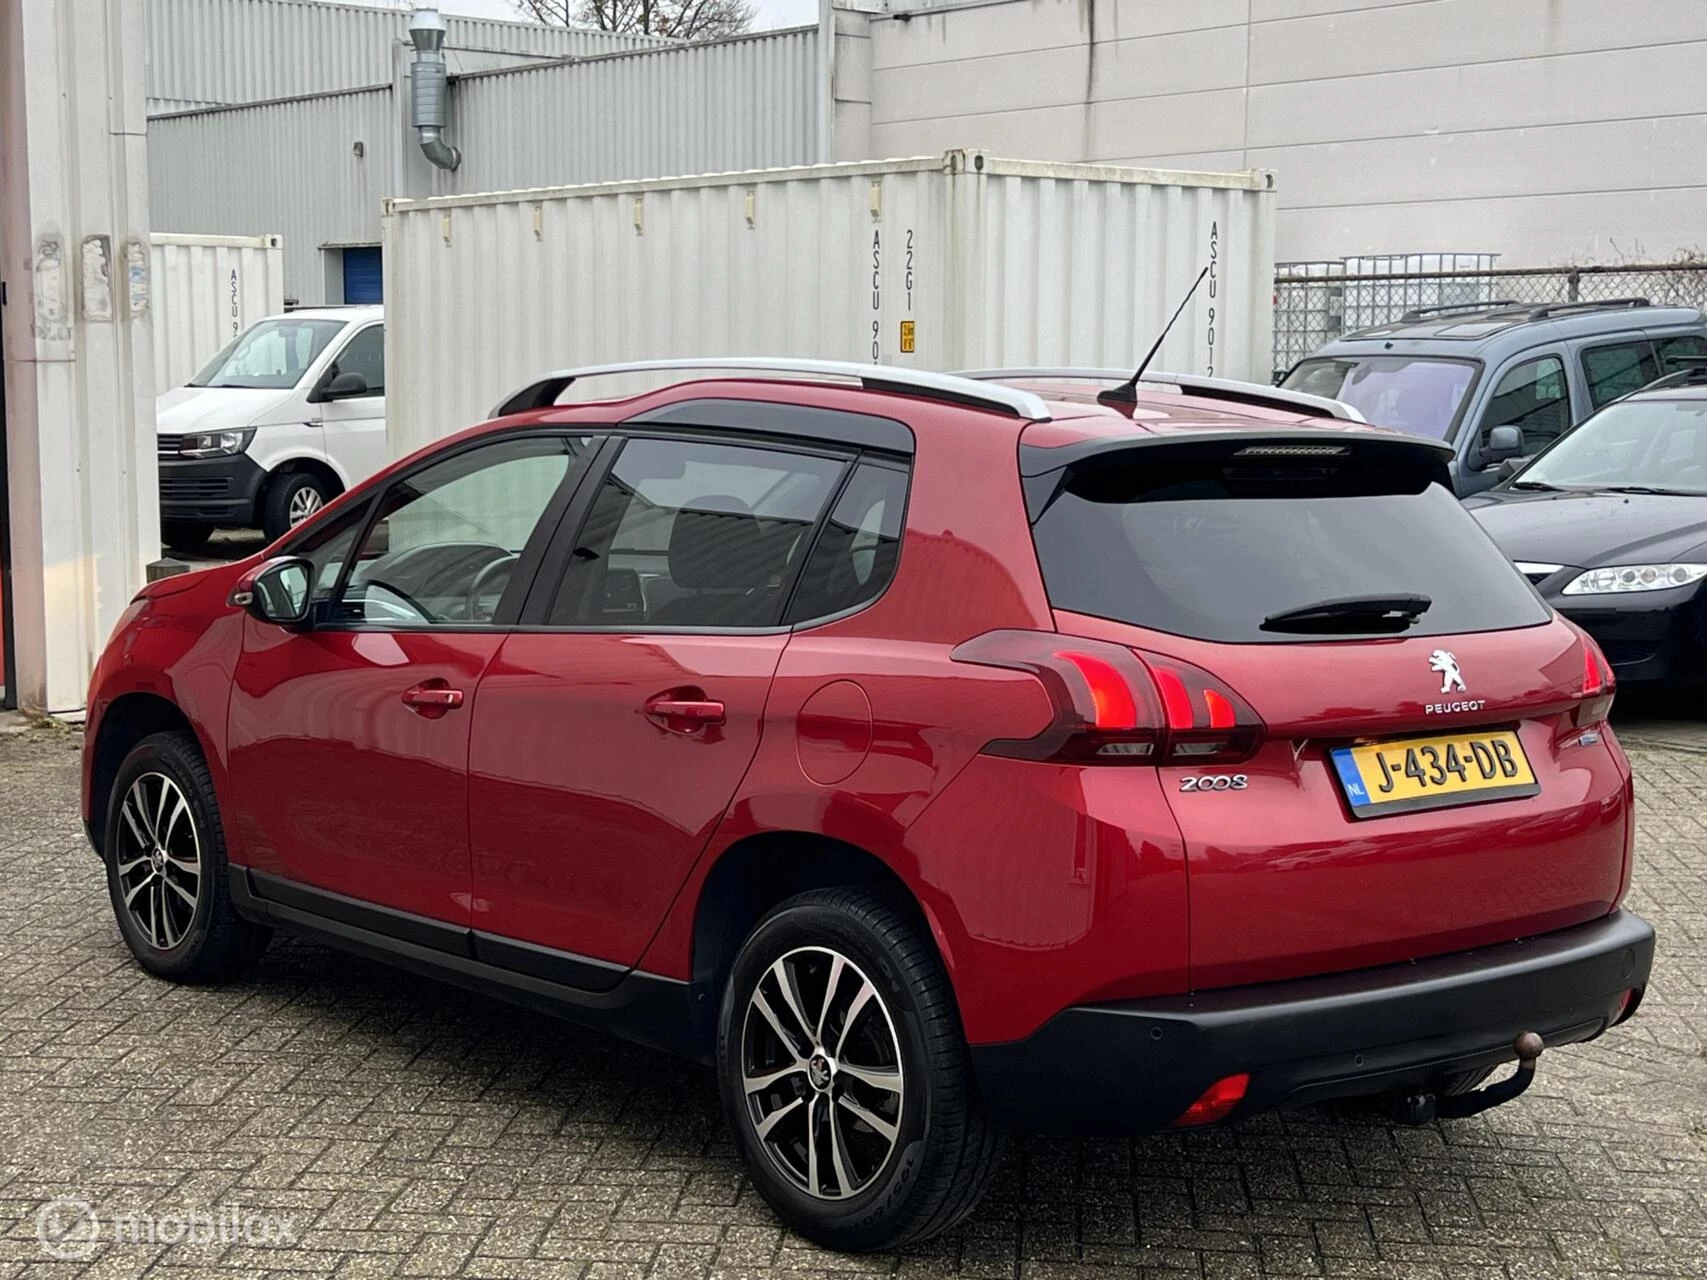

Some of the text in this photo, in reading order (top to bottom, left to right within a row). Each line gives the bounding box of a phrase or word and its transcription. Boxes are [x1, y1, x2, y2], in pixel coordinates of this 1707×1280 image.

[872, 229, 880, 310] ASCU
[905, 229, 913, 311] 22G1
[1209, 221, 1218, 298] ASCU
[1425, 700, 1486, 715] PEUGEOT
[1179, 774, 1248, 792] 2008
[1347, 739, 1518, 796] NL J-434-DB
